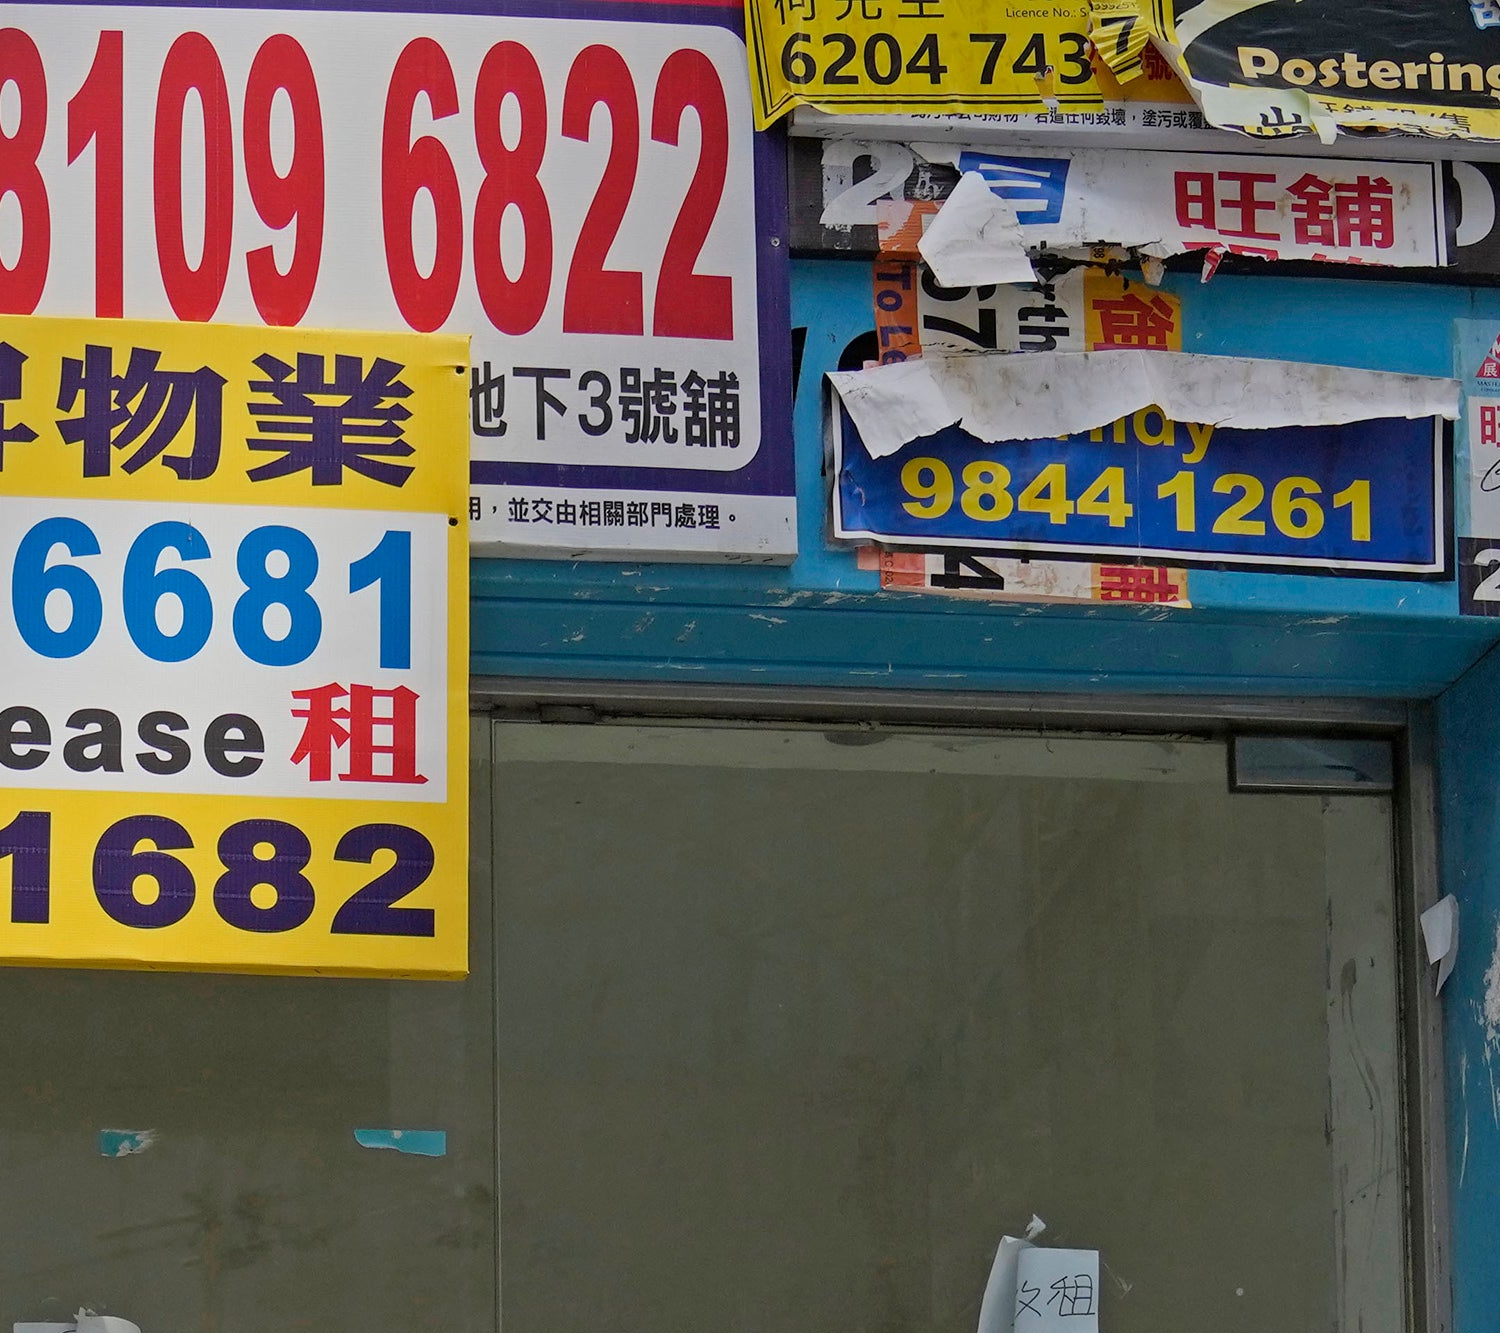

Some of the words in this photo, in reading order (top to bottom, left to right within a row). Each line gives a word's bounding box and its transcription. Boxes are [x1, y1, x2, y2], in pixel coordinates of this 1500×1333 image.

[1005, 7, 1049, 18] Licence
[780, 32, 948, 87] 6204
[381, 38, 736, 342] 6822
[1173, 170, 1395, 250] 旺舖
[900, 456, 1134, 529] 9844
[1157, 470, 1373, 542] 1261
[10, 515, 413, 672] 6681
[289, 681, 430, 786] 租
